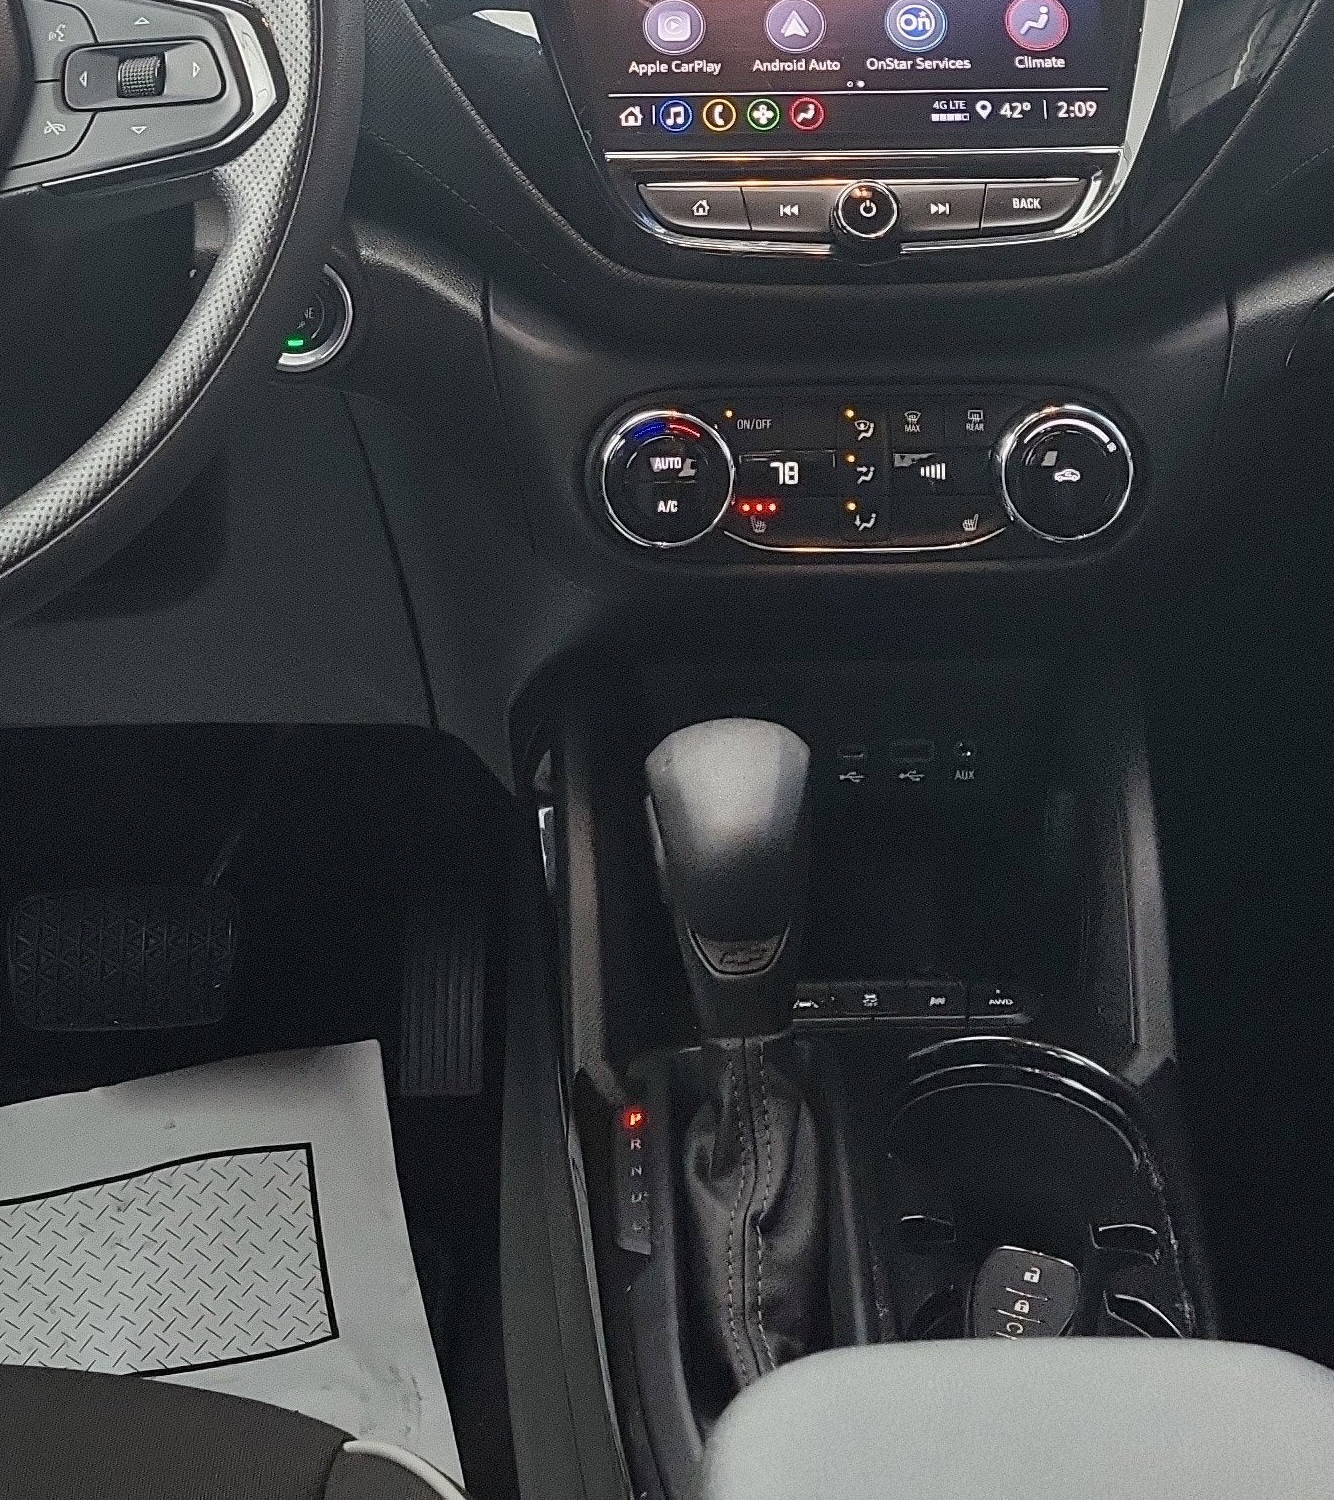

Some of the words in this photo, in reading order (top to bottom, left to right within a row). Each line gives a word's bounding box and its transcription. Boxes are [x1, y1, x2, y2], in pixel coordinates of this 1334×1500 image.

[629, 60, 669, 76] Apple
[671, 60, 722, 76] CarPlay
[752, 58, 806, 72] Android
[809, 58, 841, 71] Auto
[866, 58, 913, 70] OnStar
[916, 57, 971, 70] Services
[1015, 56, 1066, 69] Climate
[932, 101, 948, 110] 4G
[949, 100, 967, 110] LTE
[1057, 101, 1098, 118] 2:09
[1012, 197, 1041, 210] BACK
[737, 419, 772, 431] ON/OFF
[904, 424, 921, 432] MAX
[966, 423, 985, 431] REAR
[654, 457, 682, 470] AUTO
[770, 461, 799, 485] 78
[657, 500, 678, 513] A/C
[954, 770, 975, 781] AUX
[630, 1112, 642, 1126] P
[630, 1139, 642, 1150] R
[630, 1165, 642, 1176] N
